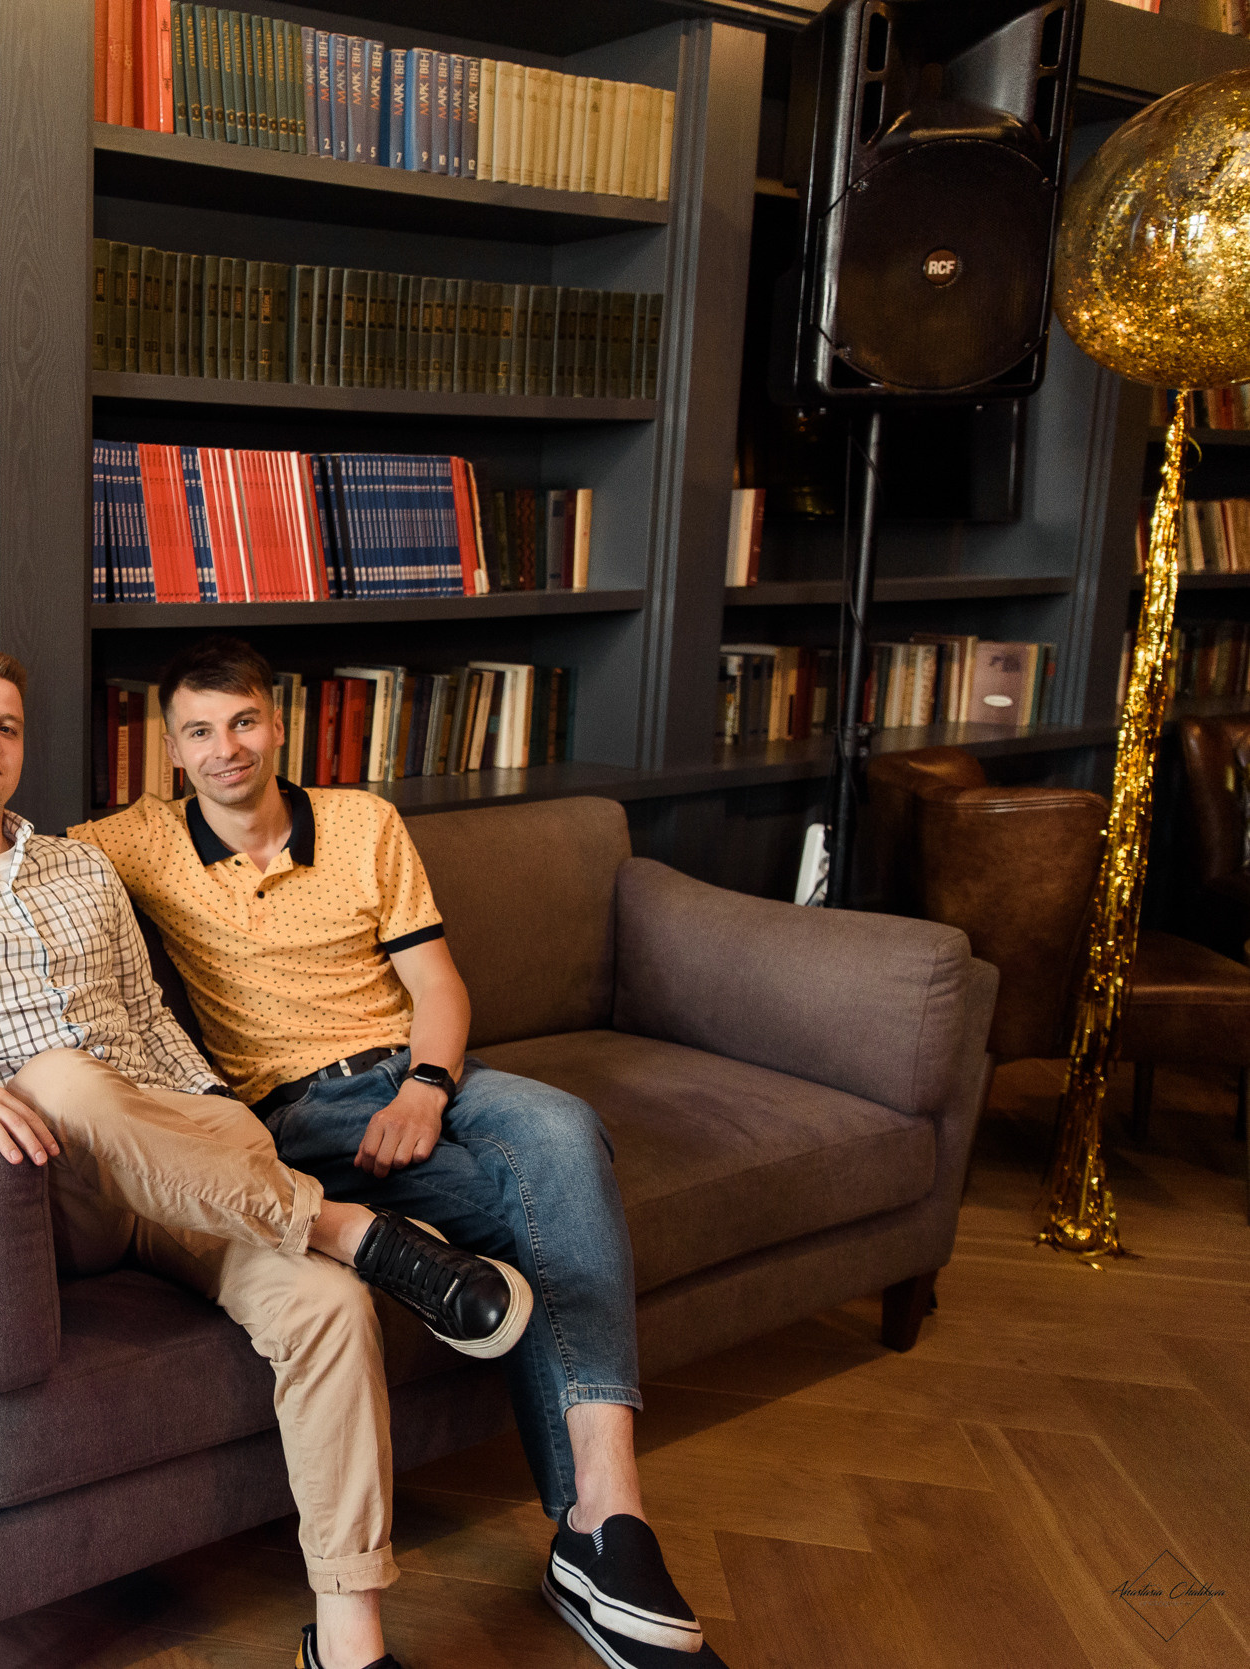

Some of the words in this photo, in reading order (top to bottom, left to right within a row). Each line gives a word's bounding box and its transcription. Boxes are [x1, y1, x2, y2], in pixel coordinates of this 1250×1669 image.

[318, 34, 328, 63] ТВЕН
[336, 37, 346, 66] ТВЕН
[351, 40, 361, 69] ТВЕН
[371, 44, 382, 72] ТВЕН
[394, 52, 405, 79] ТВЕН
[419, 52, 430, 79] ТВЕН
[438, 55, 448, 83] ТВЕН
[453, 59, 463, 85] ТВЕН
[468, 61, 479, 88] ТВЕН
[319, 66, 329, 101] МАРК
[336, 69, 346, 104] МАРК
[352, 71, 361, 105] МАРК
[370, 75, 381, 110] МАРК
[394, 83, 404, 116] МАРК
[419, 83, 429, 116] МАРК
[438, 86, 447, 119] МАРК
[453, 87, 462, 121] МАРК
[468, 90, 478, 124] МАРК
[323, 137, 330, 150] 2
[339, 140, 345, 152] 3
[355, 143, 362, 154] 4
[370, 146, 377, 158] 5
[422, 151, 429, 163] 9
[395, 152, 402, 163] 7
[438, 154, 447, 165] 10
[453, 156, 460, 167] 11
[468, 159, 476, 170] 12
[928, 260, 956, 275] RCF
